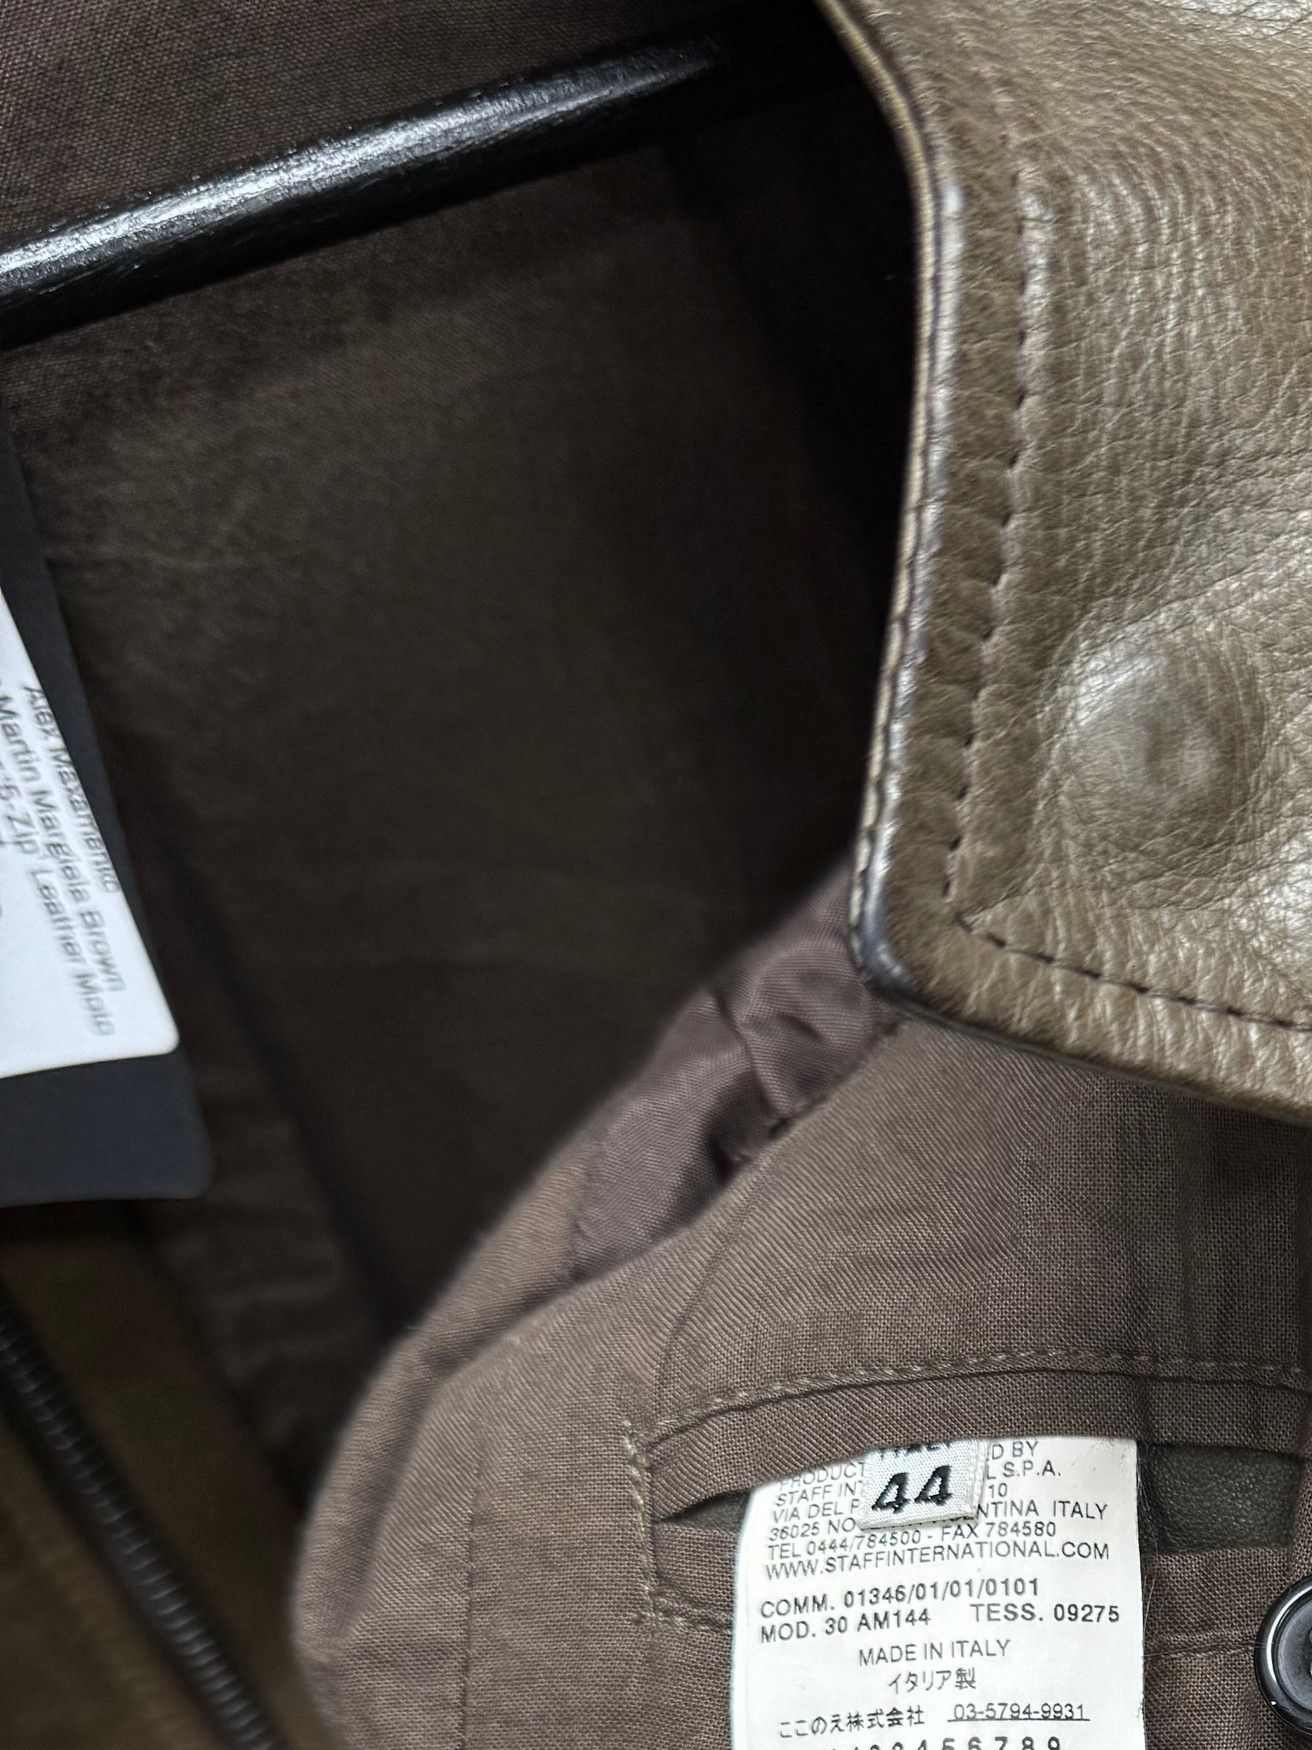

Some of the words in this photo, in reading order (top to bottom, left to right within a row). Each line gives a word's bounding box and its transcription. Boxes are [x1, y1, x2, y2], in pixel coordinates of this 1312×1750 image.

[30, 868, 87, 963] Leather
[1012, 1441, 1039, 1457] BY
[776, 1484, 833, 1507] STAFF
[1003, 1460, 1061, 1477] S.P.A.
[871, 1464, 954, 1514] 44
[769, 1522, 820, 1541] 36025
[976, 1500, 1039, 1518] NTINA
[1053, 1501, 1108, 1519] ITALY
[773, 1506, 799, 1523] VIA
[808, 1503, 843, 1519] DEL
[768, 1543, 800, 1560] TEL
[807, 1530, 921, 1556] 0444/784500
[942, 1523, 979, 1541] FAX
[986, 1521, 1056, 1537] 784580
[766, 1541, 1109, 1580] WWW.STAFFINTERNATIONAL.COM
[761, 1594, 835, 1618] COMM.
[844, 1578, 1038, 1608] 01346/01/01/0101
[761, 1621, 816, 1643] MOD.
[825, 1616, 848, 1635] 30
[857, 1608, 931, 1631] AM144
[970, 1603, 1043, 1622] TESS.
[1054, 1604, 1120, 1622] 09275
[859, 1643, 917, 1666] MADE
[924, 1642, 943, 1660] IN
[952, 1639, 1010, 1657] ITALY
[888, 1667, 976, 1694] イタリア製
[780, 1705, 925, 1738] ここのえ株式会社
[953, 1702, 1085, 1721] 03-5794-9931
